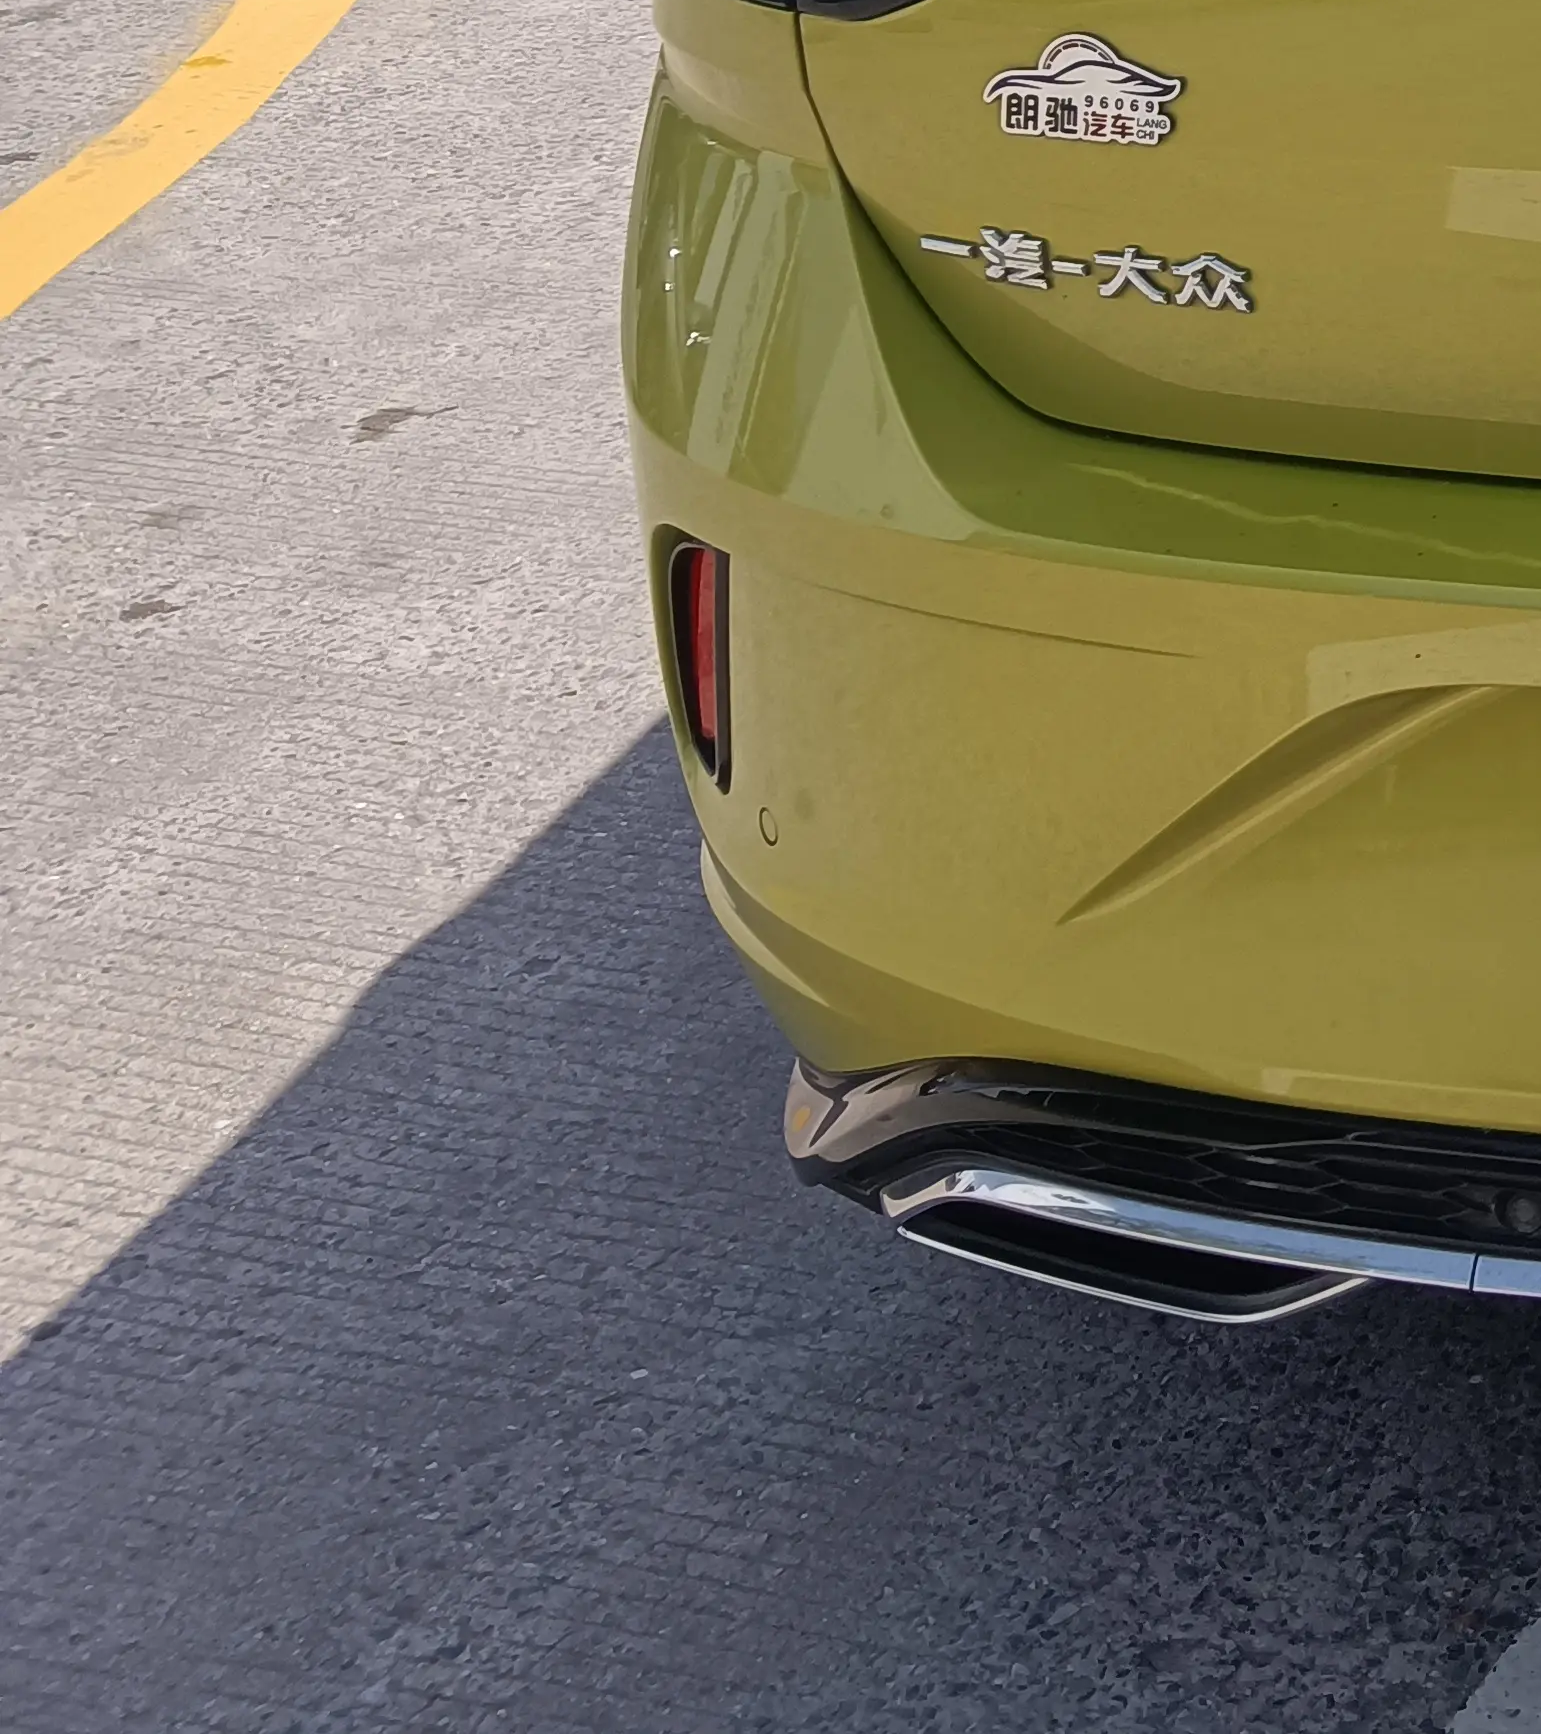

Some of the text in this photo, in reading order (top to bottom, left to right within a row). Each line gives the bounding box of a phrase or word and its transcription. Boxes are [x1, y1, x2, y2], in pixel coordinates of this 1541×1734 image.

[1084, 95, 1155, 113] 96069
[1136, 117, 1168, 129] LANG
[1136, 130, 1155, 140] CHI
[919, 225, 1253, 313] 一汽-大众
